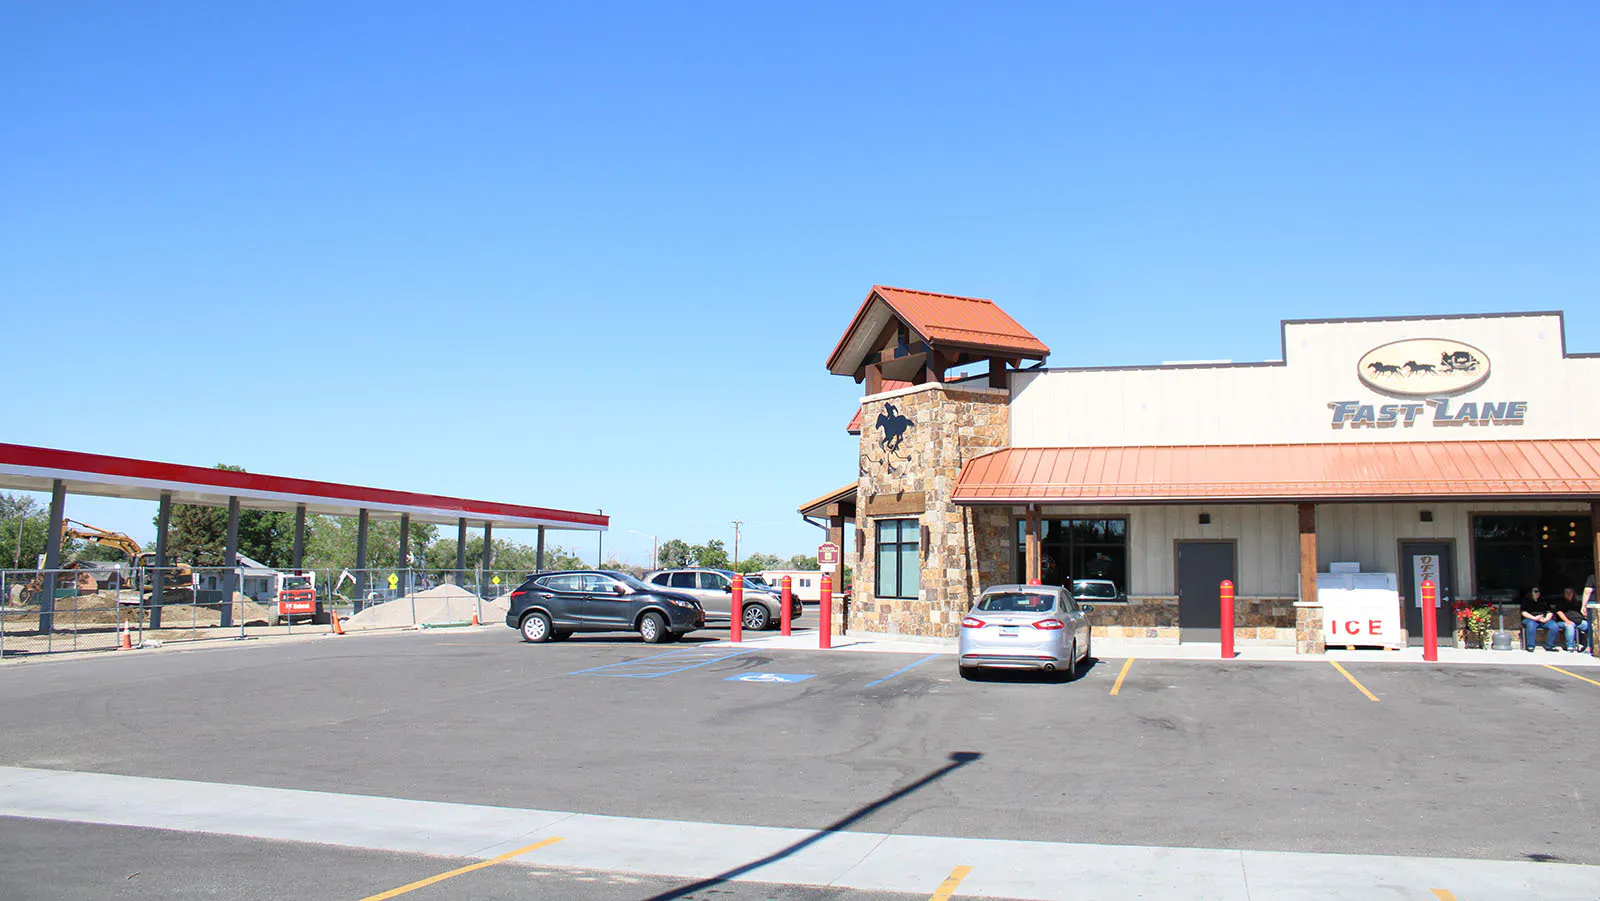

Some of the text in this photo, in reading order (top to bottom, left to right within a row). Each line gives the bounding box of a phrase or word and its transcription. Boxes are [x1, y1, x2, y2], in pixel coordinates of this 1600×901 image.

[1327, 398, 1528, 429] FAST LANE
[1420, 555, 1433, 581] OFF
[1331, 620, 1382, 635] ICE
